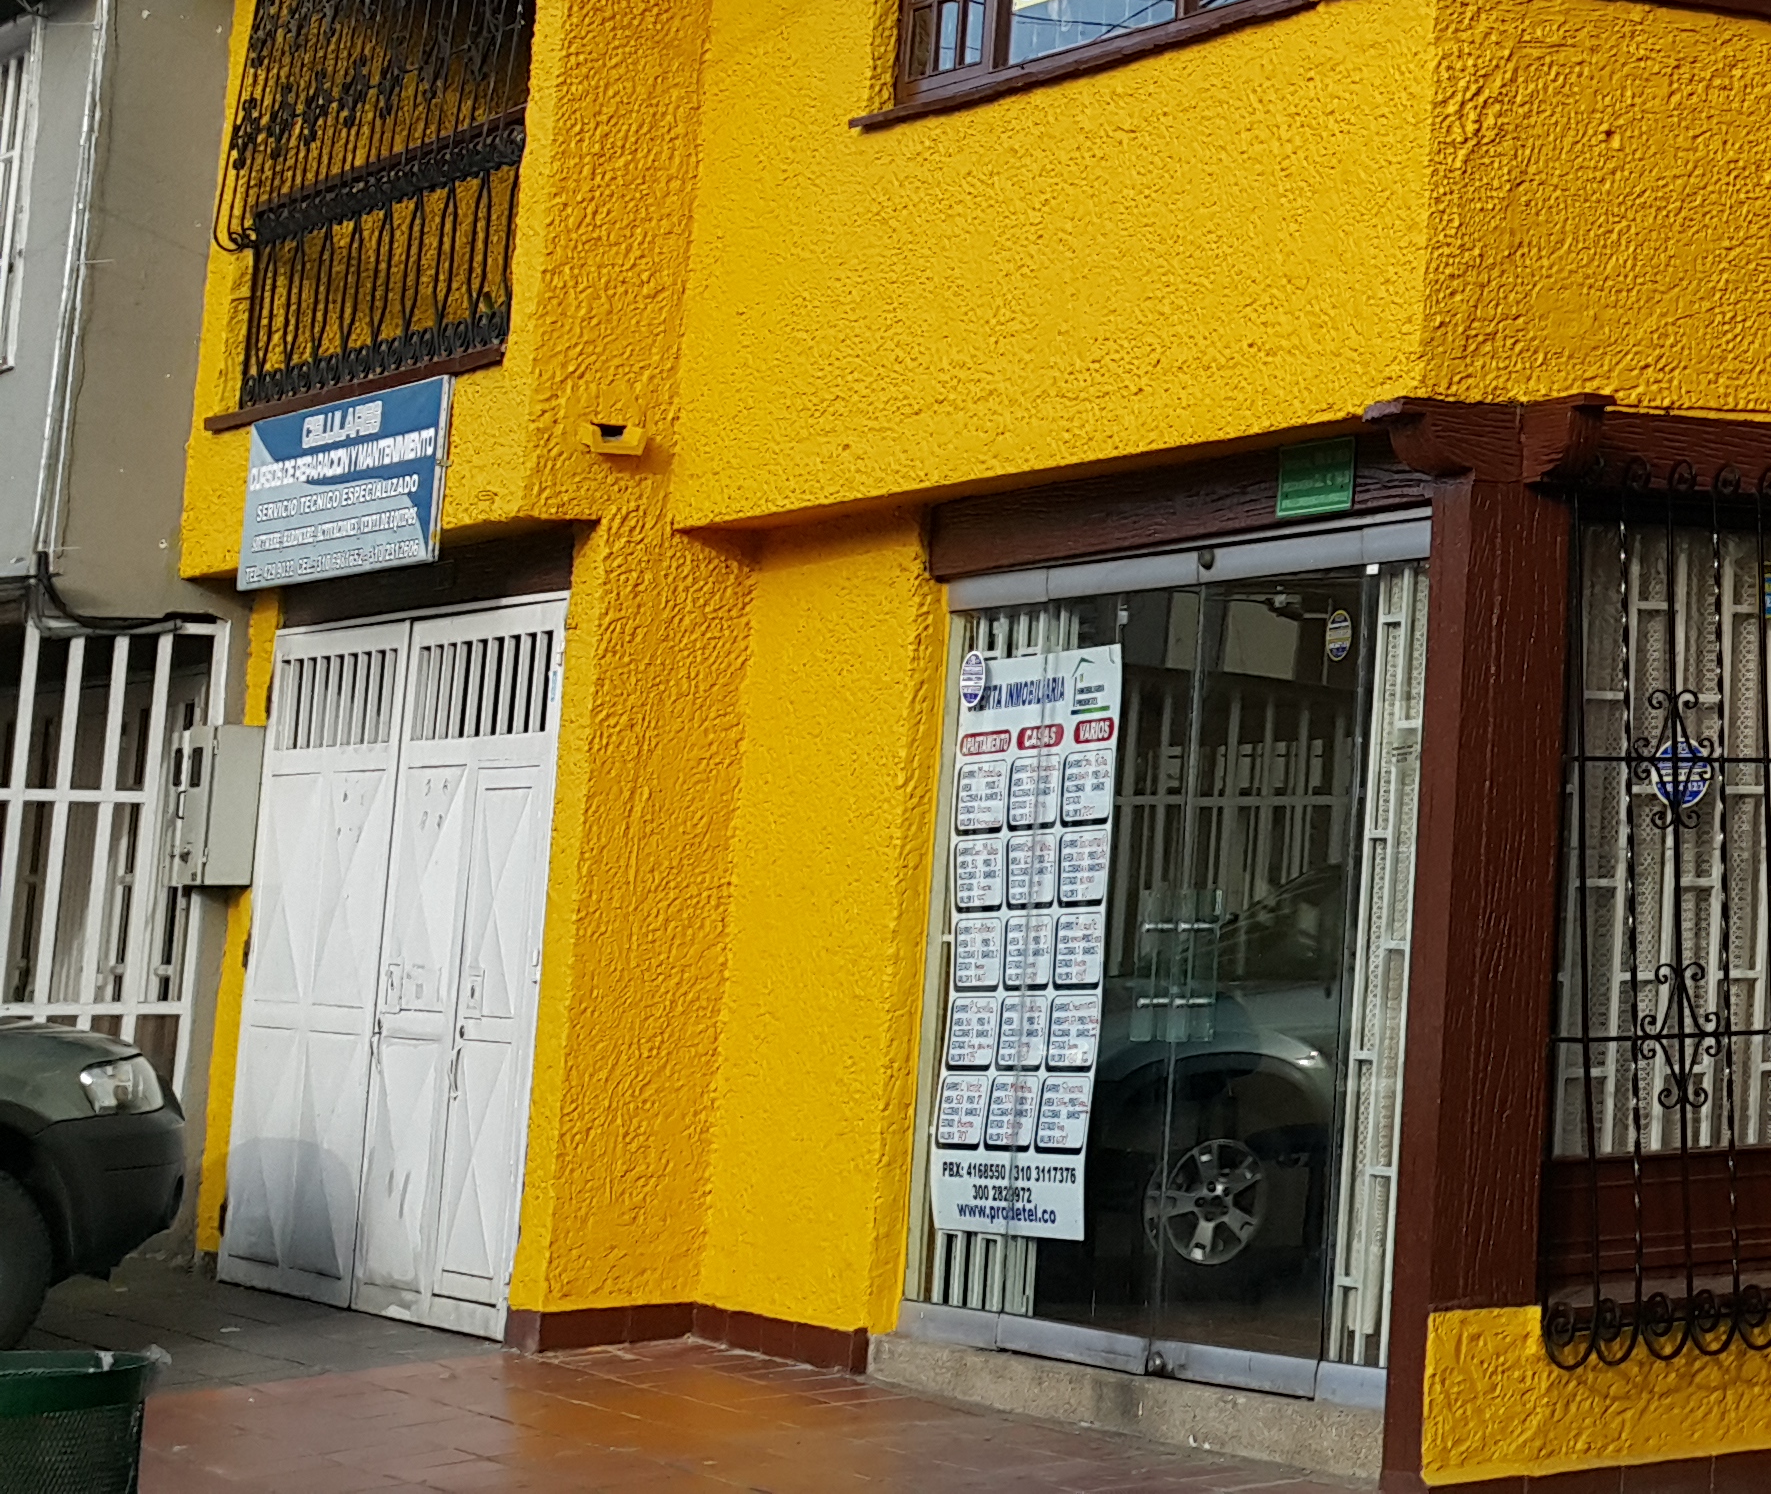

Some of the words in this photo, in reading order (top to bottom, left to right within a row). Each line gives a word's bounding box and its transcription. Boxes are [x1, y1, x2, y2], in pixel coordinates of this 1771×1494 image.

[302, 400, 382, 448] CELULARES
[256, 498, 297, 522] SERVICIO
[299, 490, 340, 515] TECNICO
[341, 474, 419, 507] ESPECIALIZADO
[1024, 727, 1057, 747] CASAS
[1080, 721, 1111, 741] VARIOS
[942, 1161, 964, 1178] PBX:
[1014, 1165, 1032, 1181] 310
[1035, 1166, 1076, 1184] 3117376
[972, 1184, 989, 1201] 300
[957, 1203, 1056, 1224] www.prodetel.co
